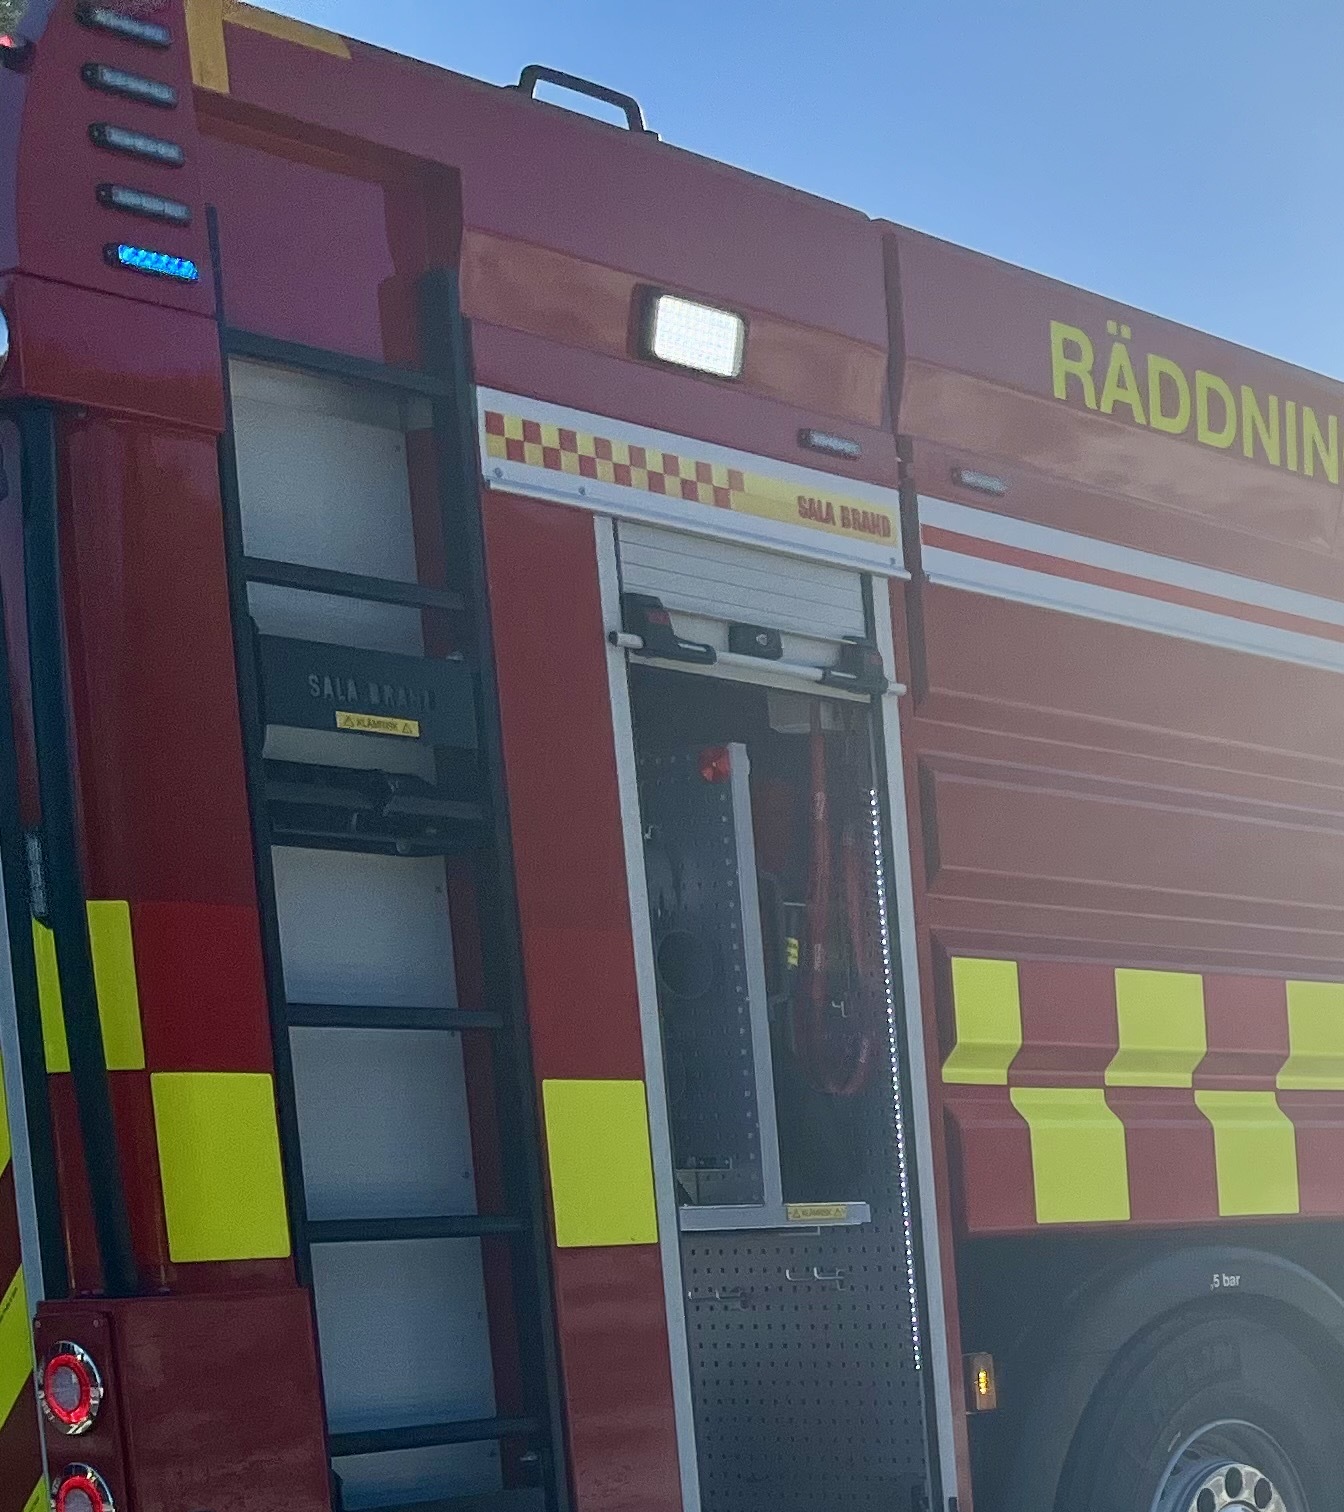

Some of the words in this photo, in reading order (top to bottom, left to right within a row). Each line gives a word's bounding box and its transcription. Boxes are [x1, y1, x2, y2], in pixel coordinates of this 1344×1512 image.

[797, 495, 836, 526] SALA
[839, 505, 892, 537] BRAND
[308, 673, 358, 702] SALA
[1222, 1273, 1241, 1287] bar
